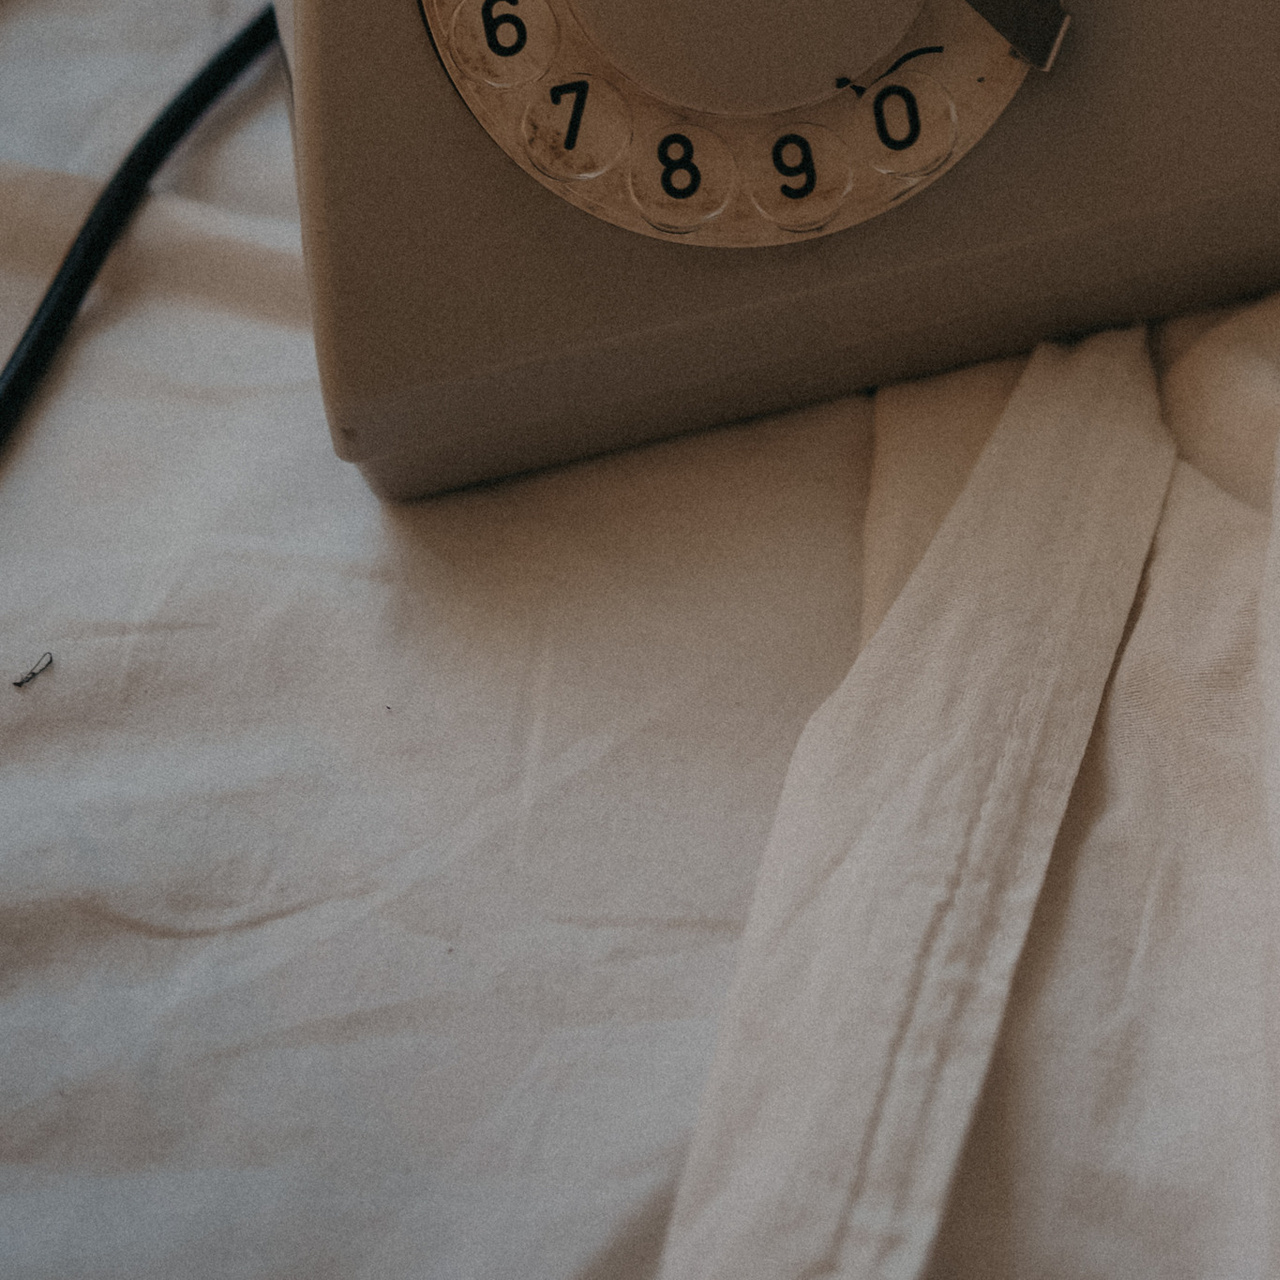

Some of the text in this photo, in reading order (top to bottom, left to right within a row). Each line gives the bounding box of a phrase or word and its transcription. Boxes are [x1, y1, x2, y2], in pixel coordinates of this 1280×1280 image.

[549, 80, 590, 151] 7
[872, 84, 921, 151] 0
[657, 132, 702, 200] 8
[771, 133, 817, 200] 9
